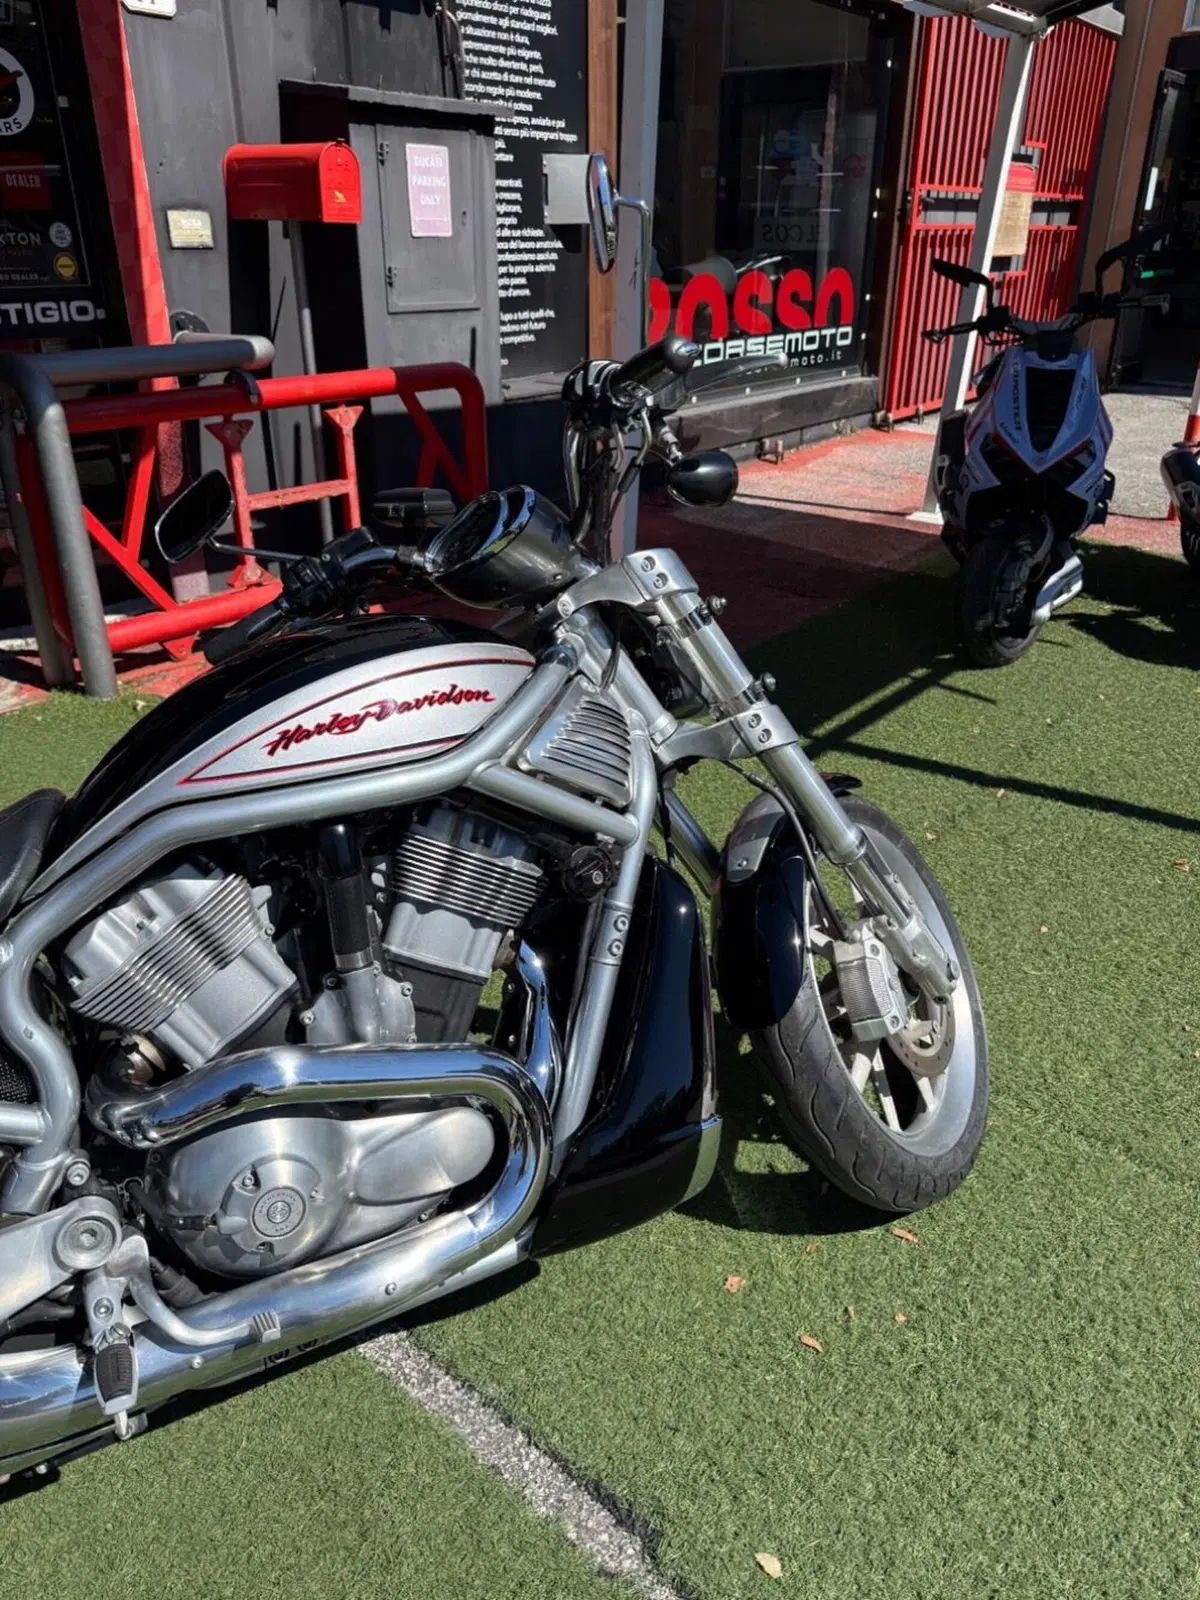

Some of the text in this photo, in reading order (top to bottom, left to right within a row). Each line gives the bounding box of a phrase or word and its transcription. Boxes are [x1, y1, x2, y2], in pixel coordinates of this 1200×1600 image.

[509, 5, 520, 15] per
[456, 9, 498, 25] giornalmente
[498, 17, 510, 29] agli
[510, 19, 536, 32] standard
[465, 24, 497, 39] situazione
[497, 31, 509, 41] non
[506, 45, 517, 57] più
[479, 55, 498, 67] molto
[470, 67, 480, 78] chi
[481, 69, 502, 81] accetta
[509, 73, 523, 84] stare
[523, 75, 533, 85] nel
[533, 78, 557, 88] mercato
[486, 85, 505, 98] regole
[505, 86, 516, 98] più
[513, 101, 533, 112] poteva
[503, 127, 520, 137] senza
[520, 128, 530, 139] più
[559, 132, 578, 143] troppo
[413, 155, 443, 168] DUCATI
[5, 173, 41, 188] DEALER
[411, 174, 446, 188] PARKING
[419, 193, 441, 207] ONLY
